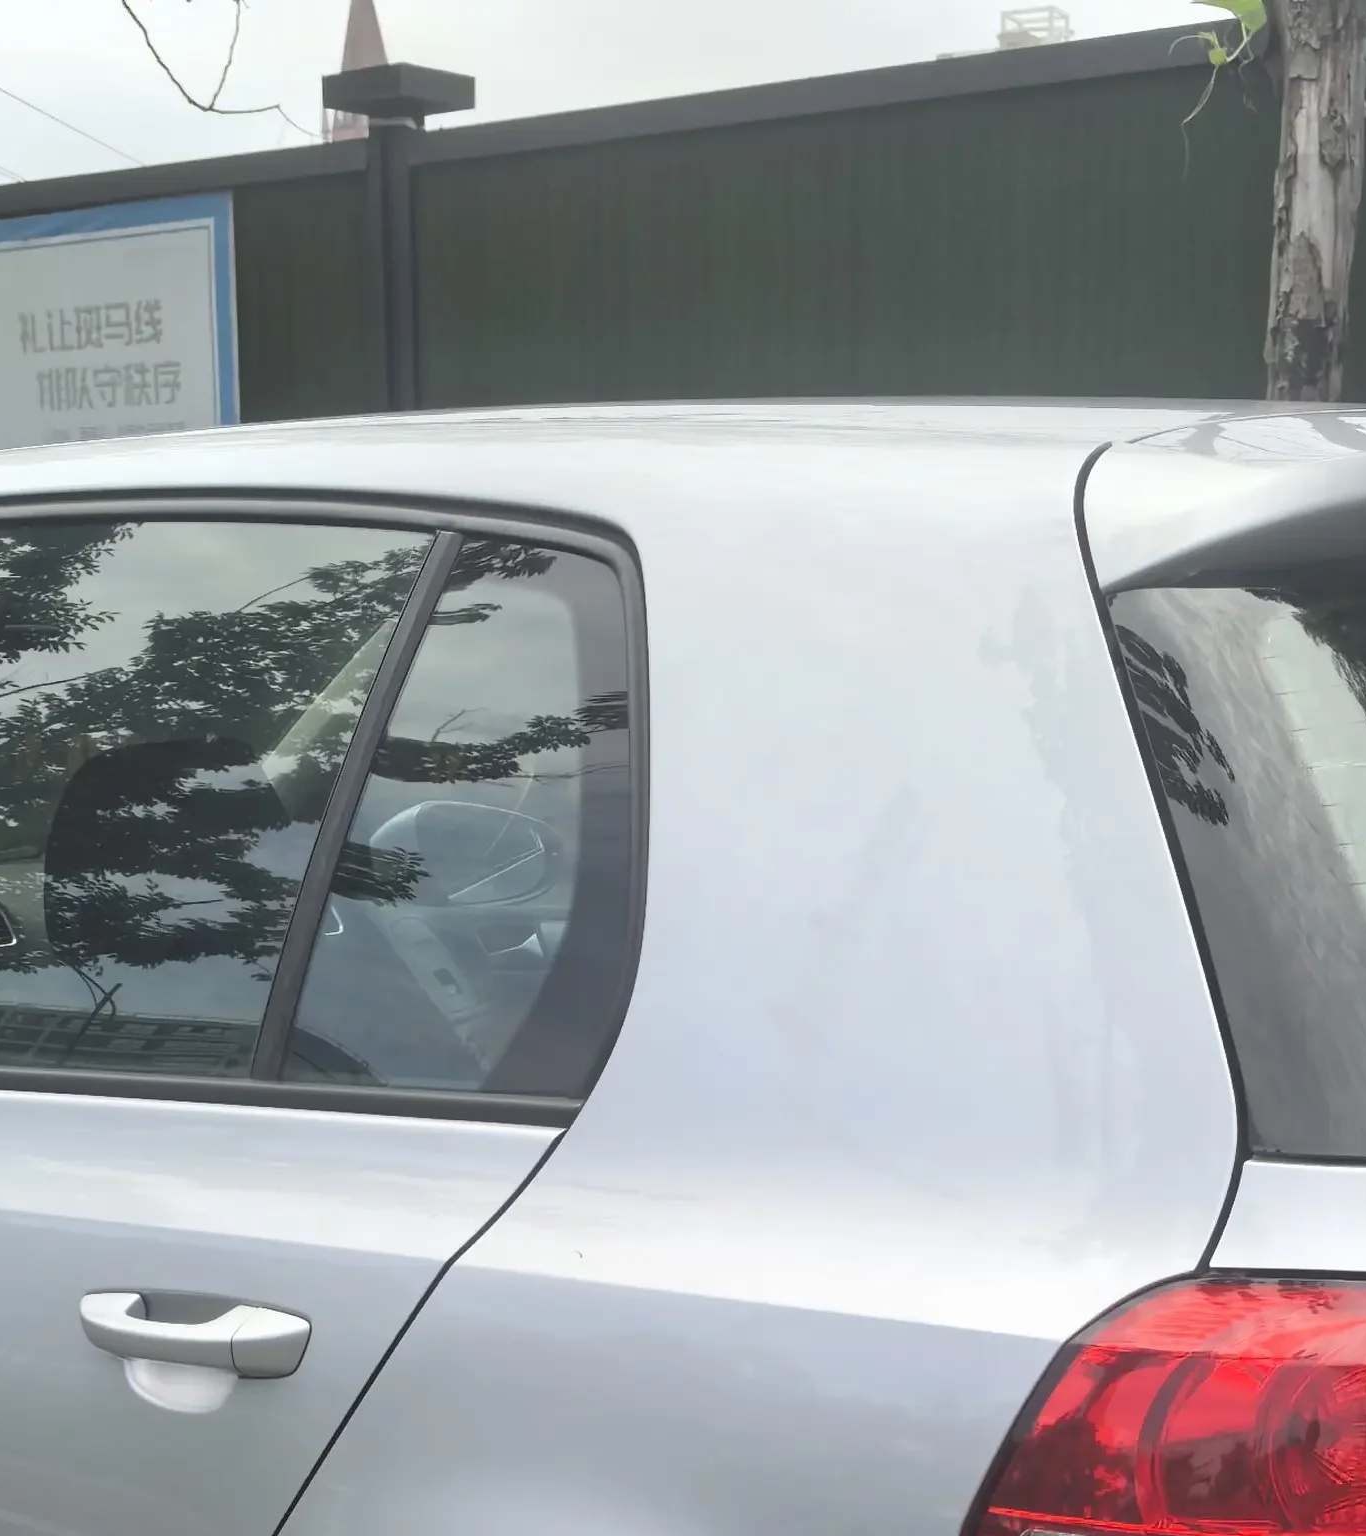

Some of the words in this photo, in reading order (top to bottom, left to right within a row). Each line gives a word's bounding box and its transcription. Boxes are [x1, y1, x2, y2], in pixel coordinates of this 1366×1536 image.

[17, 299, 163, 356] 礼让斑马线
[36, 360, 182, 411] 排队守秩序
